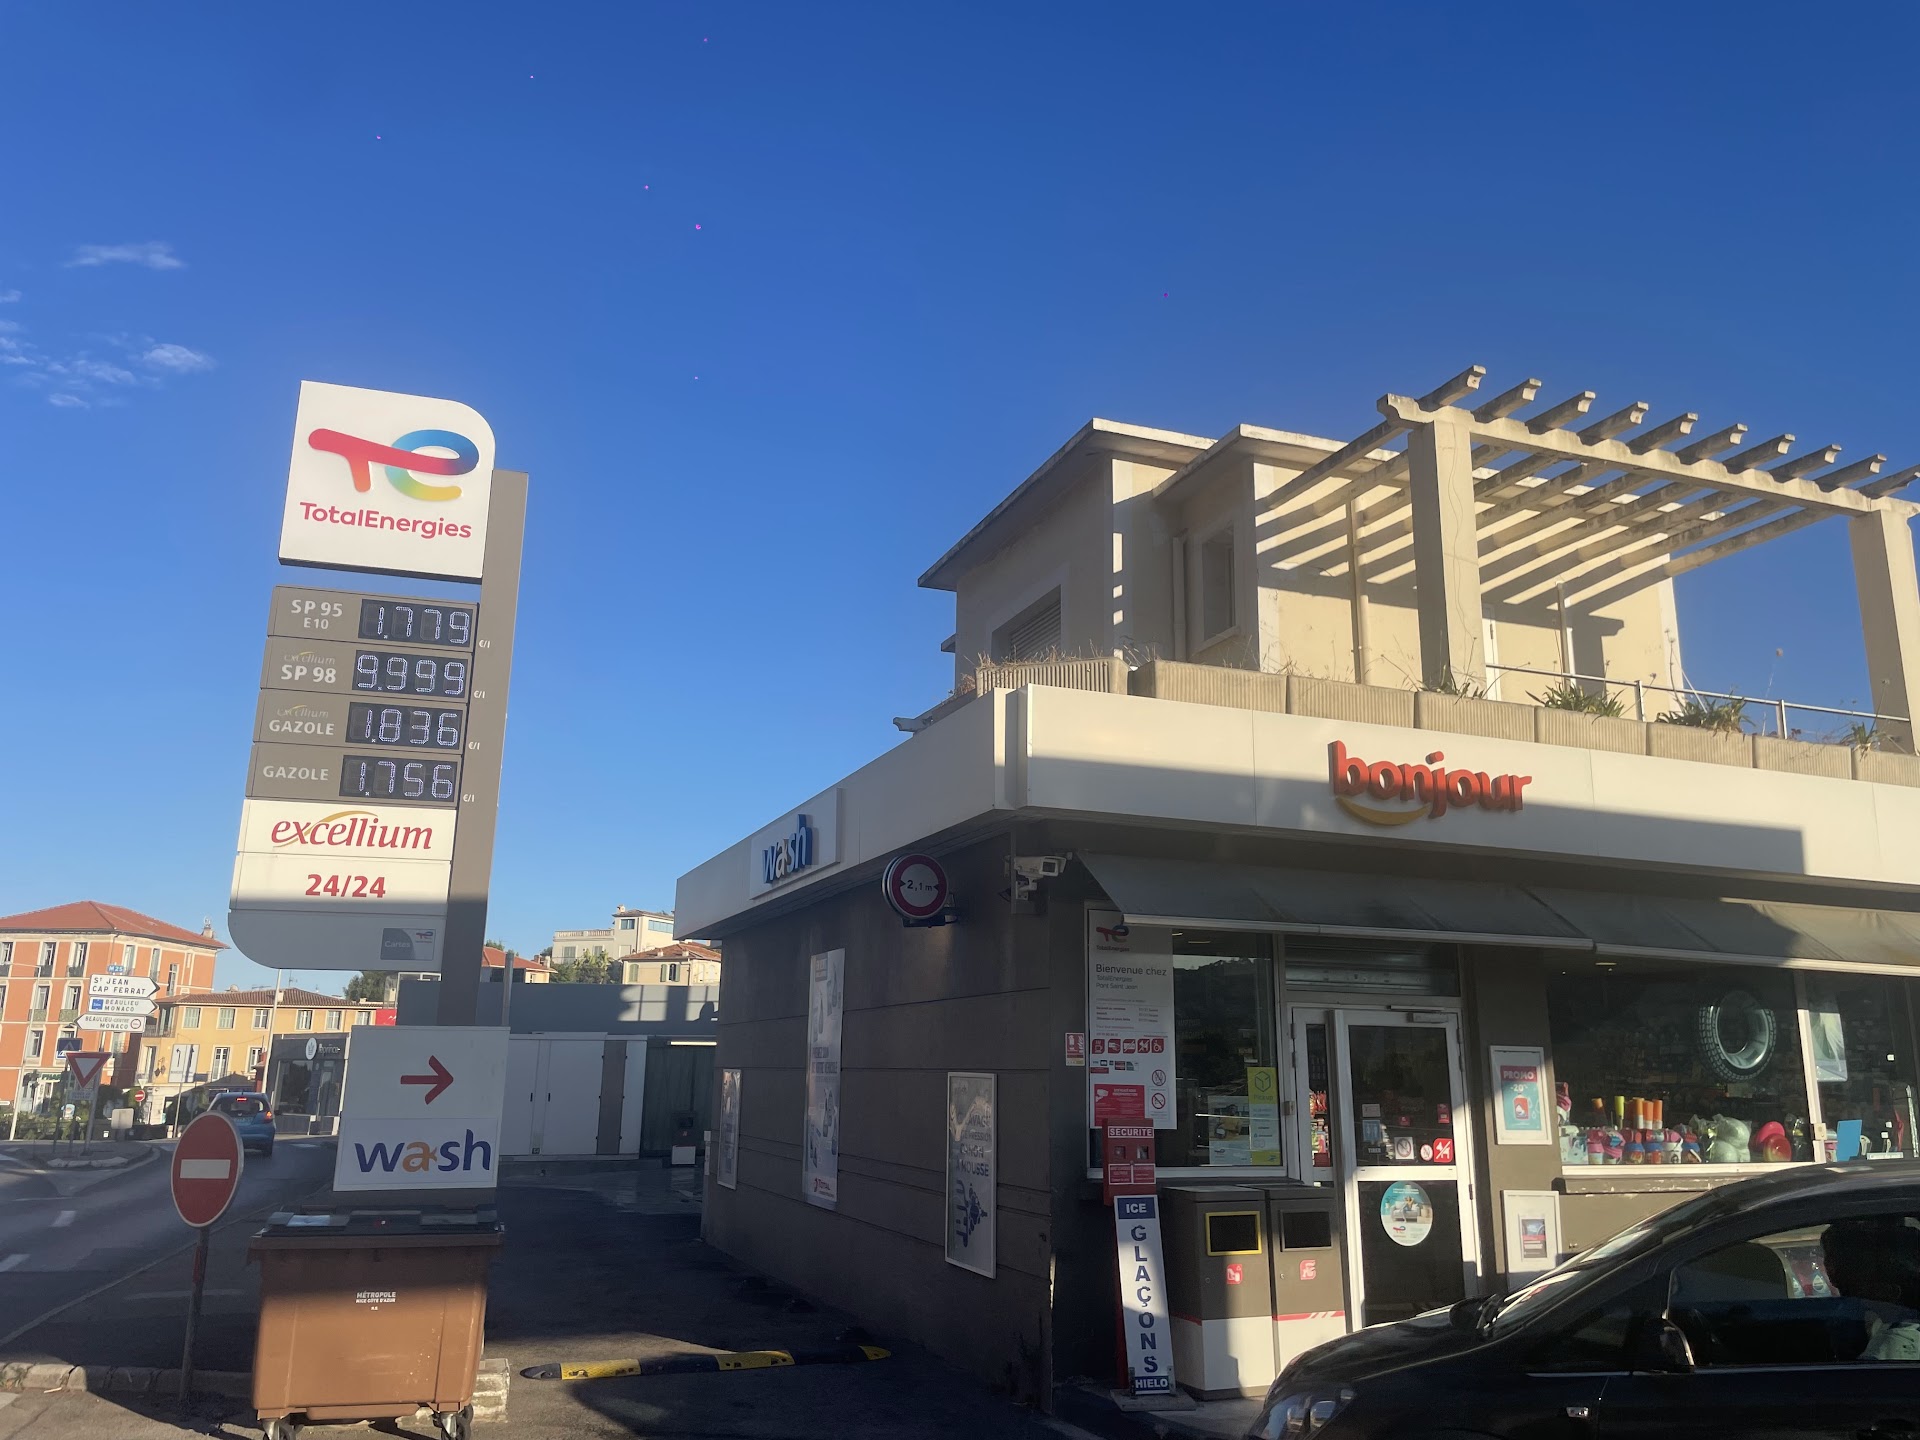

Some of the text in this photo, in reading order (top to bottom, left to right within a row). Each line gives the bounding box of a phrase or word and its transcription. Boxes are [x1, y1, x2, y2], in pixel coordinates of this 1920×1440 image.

[299, 502, 472, 539] TotalEnergies
[290, 600, 343, 618] SP 95
[284, 651, 336, 665] excellium
[281, 664, 337, 684] SP 98
[277, 704, 329, 719] excellium
[268, 719, 335, 736] GAZOLE
[262, 765, 329, 781] GAZOLE
[1327, 740, 1533, 819] bonjour
[270, 811, 433, 850] excellium
[762, 814, 813, 884] wash
[305, 873, 386, 898] 24/24
[1095, 963, 1168, 977] Bienvenue chez
[92, 985, 146, 995] CAP FERRAT
[354, 1129, 492, 1173] wash
[1125, 1203, 1147, 1214] ICE
[356, 1290, 397, 1299] MÉTROPOLE
[1135, 1377, 1168, 1389] HIELO
